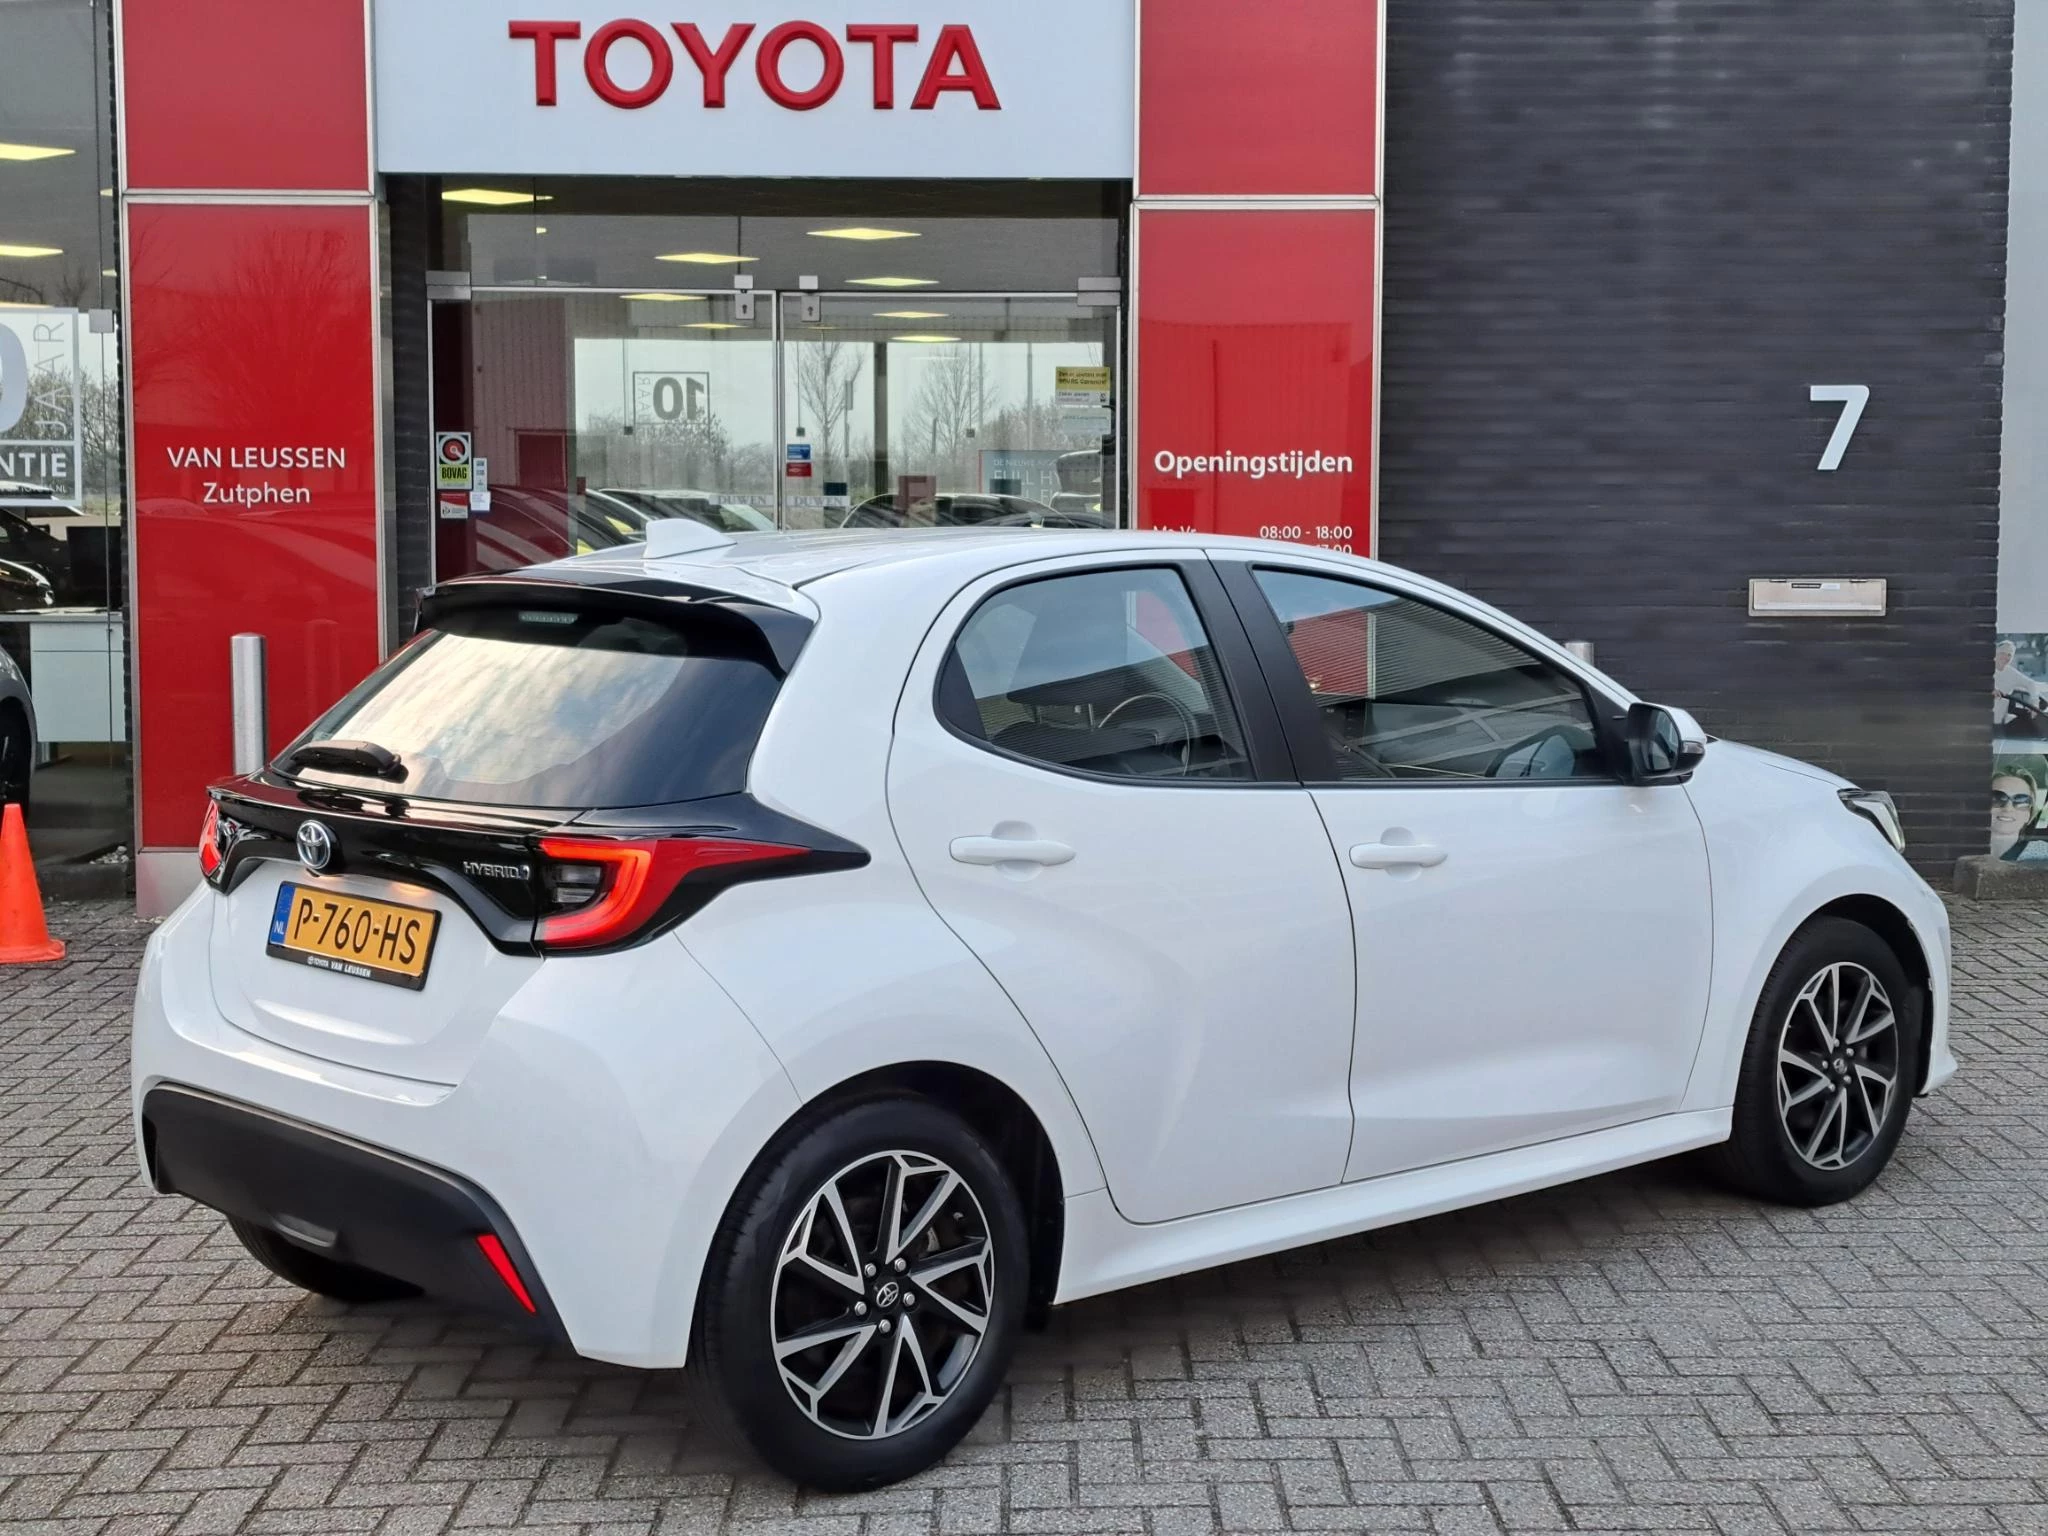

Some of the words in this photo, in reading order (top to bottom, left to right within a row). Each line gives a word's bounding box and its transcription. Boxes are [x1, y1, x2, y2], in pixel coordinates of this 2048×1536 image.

[508, 18, 1003, 111] TOYOTA
[33, 322, 67, 435] JAAR
[1810, 385, 1870, 470] 7
[167, 447, 221, 468] VAN
[230, 447, 345, 468] LEUSSEN
[1154, 450, 1353, 479] Openingstijden
[441, 466, 467, 479] BOVAG
[203, 481, 311, 508] Zutphen
[718, 495, 767, 505] DUWEN
[794, 496, 843, 507] DUWEN
[1259, 525, 1302, 539] 08:00
[1315, 525, 1353, 539] 18:00
[463, 861, 519, 879] HYBRID
[273, 920, 285, 935] NL
[294, 898, 421, 965] P-760-HS
[330, 961, 343, 971] VAN
[344, 964, 371, 978] LEUSSEN
